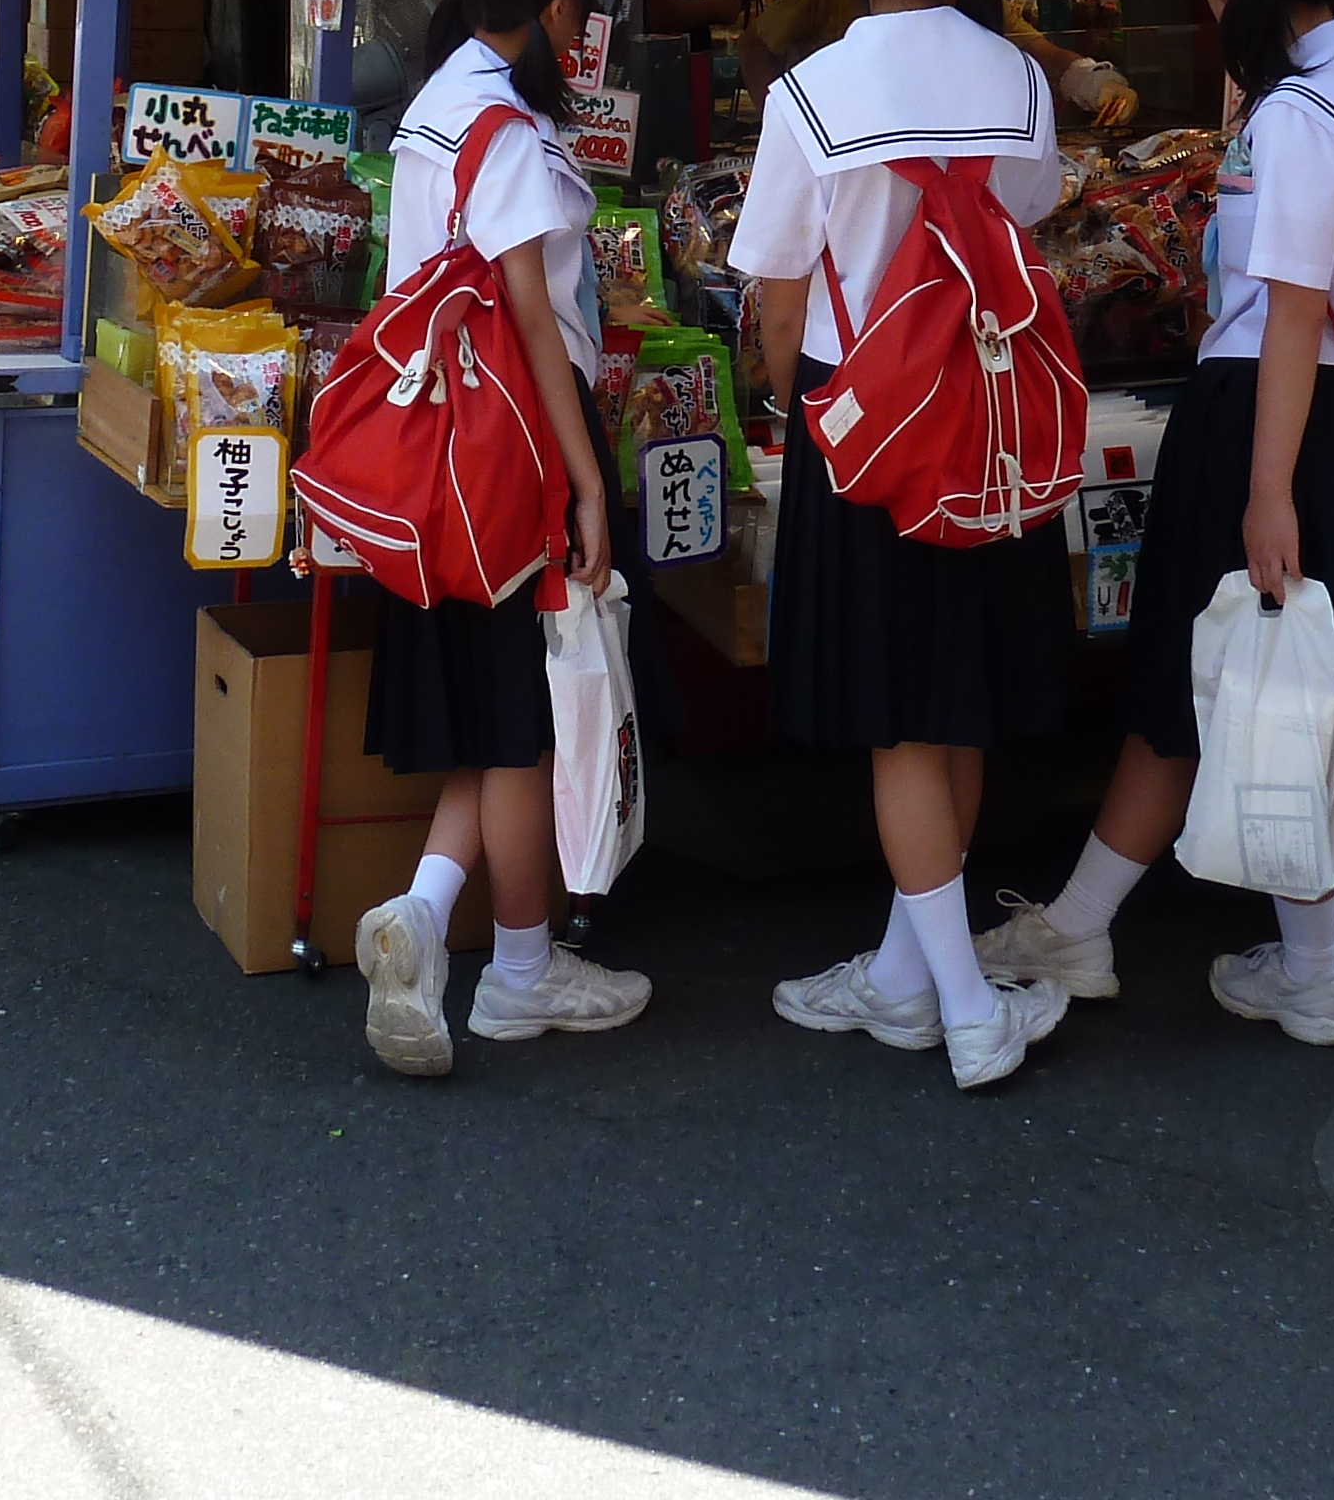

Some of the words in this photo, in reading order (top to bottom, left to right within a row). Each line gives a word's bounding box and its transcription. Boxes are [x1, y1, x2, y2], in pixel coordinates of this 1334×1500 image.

[146, 94, 216, 128] 小丸
[251, 102, 350, 145] ねぎ味噌
[132, 125, 236, 159] せんべい
[659, 449, 695, 559] ぬれせん
[696, 458, 718, 547] べっちゃり
